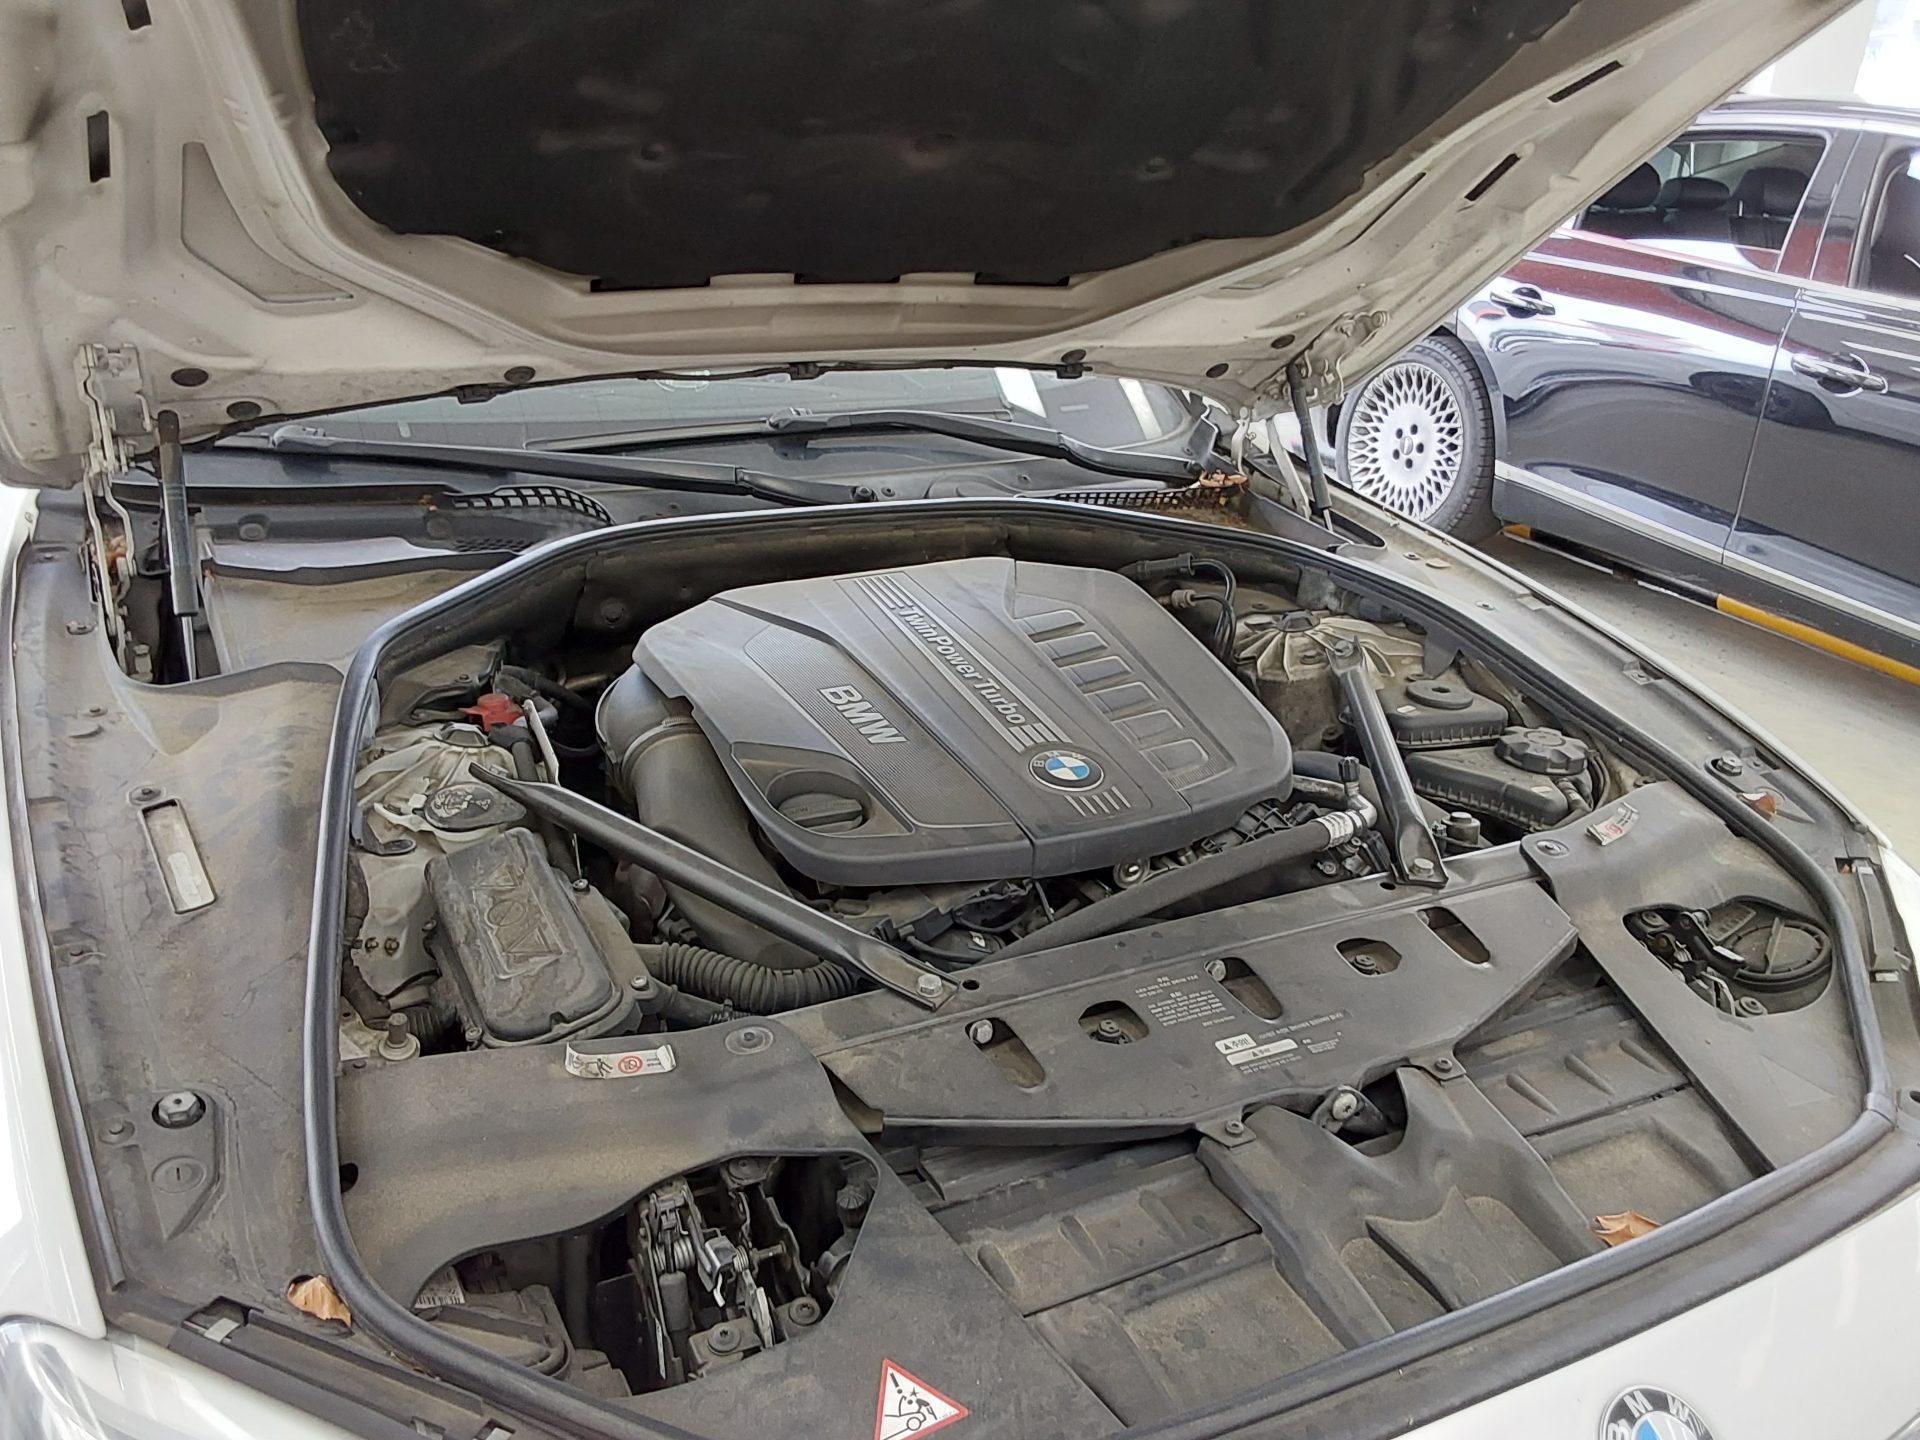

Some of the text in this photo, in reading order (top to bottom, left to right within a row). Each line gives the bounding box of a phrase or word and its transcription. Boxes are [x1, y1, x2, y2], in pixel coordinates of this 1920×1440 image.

[899, 606, 1026, 724] TwinPower Turbo
[819, 685, 908, 744] BMW
[1032, 750, 1087, 769] BMW
[1607, 1389, 1690, 1440] BMW
